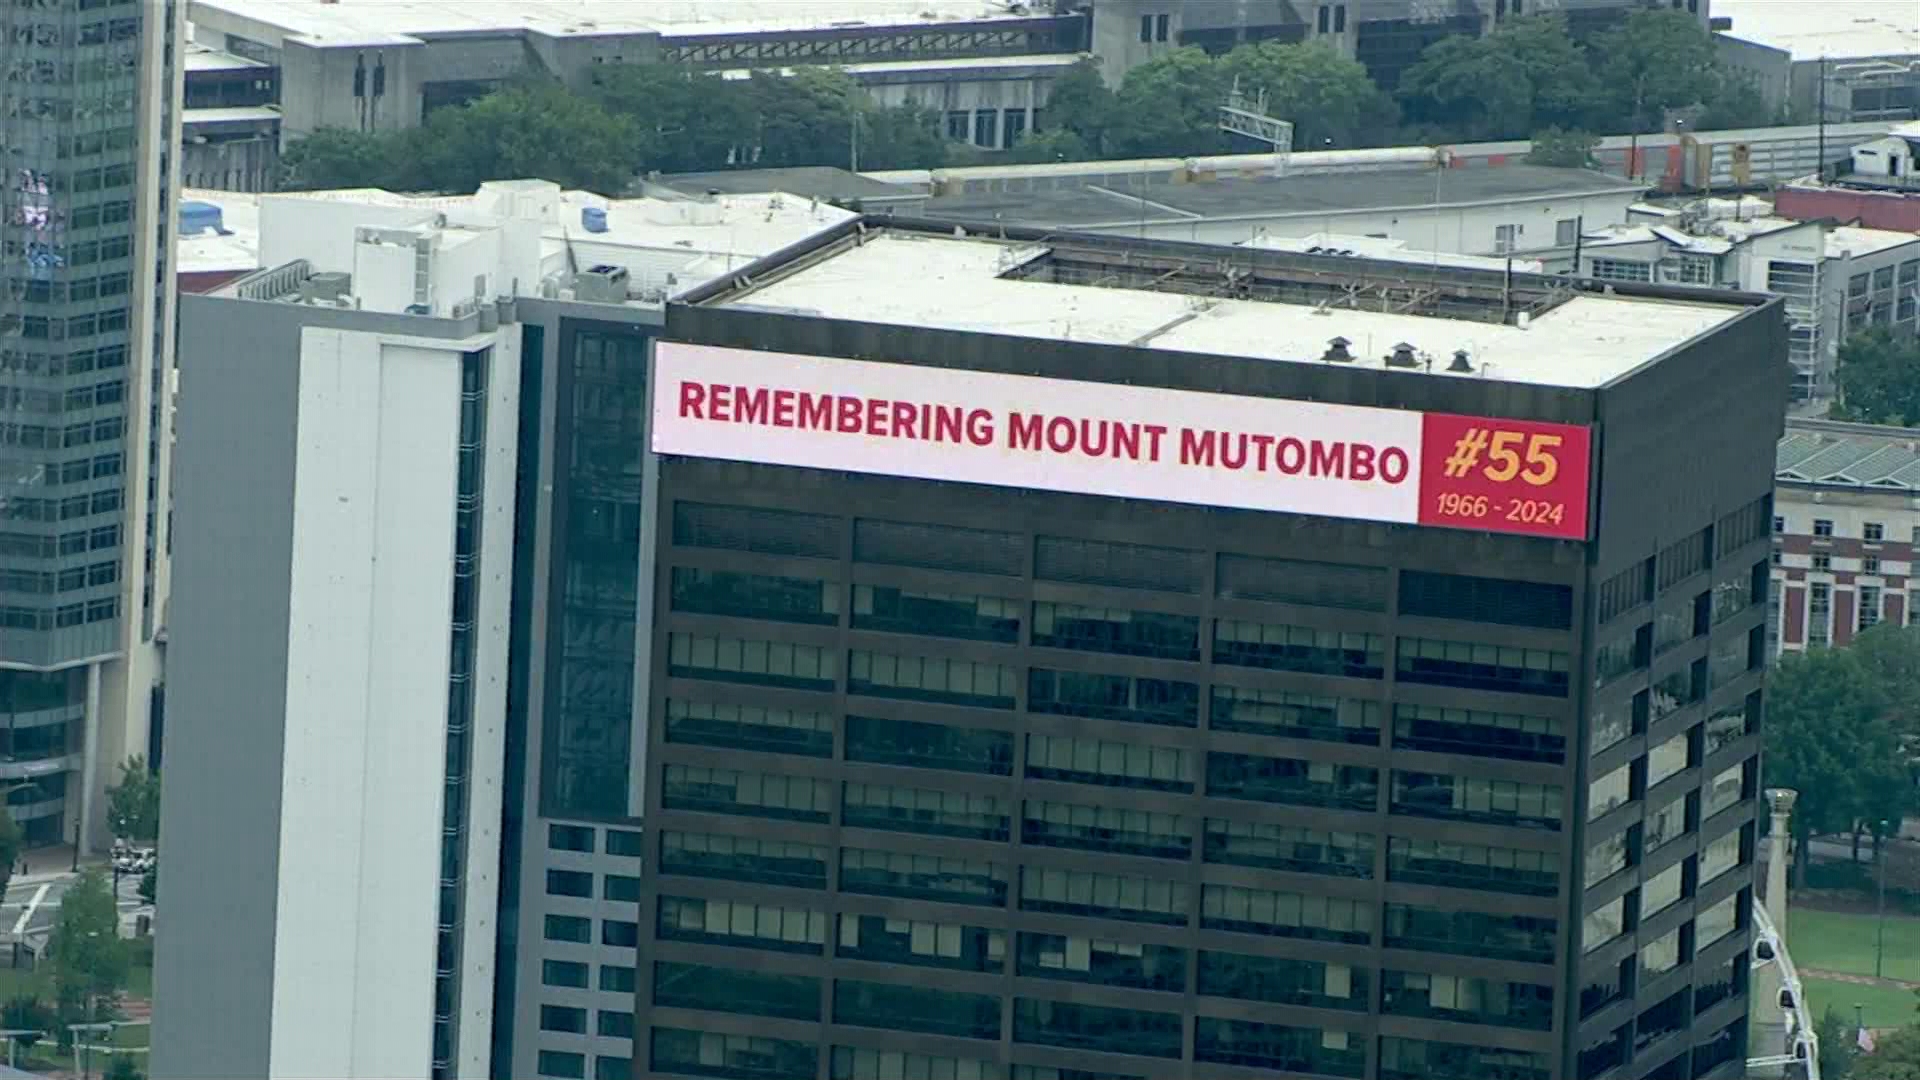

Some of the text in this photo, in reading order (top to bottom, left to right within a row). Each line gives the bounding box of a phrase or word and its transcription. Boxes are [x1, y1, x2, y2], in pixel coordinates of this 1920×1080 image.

[679, 381, 1409, 485] REMEMBERING MOUNT MUTOMBO
[1445, 428, 1563, 486] #55
[1438, 493, 1490, 518] 1966
[1506, 500, 1565, 526] 2024
